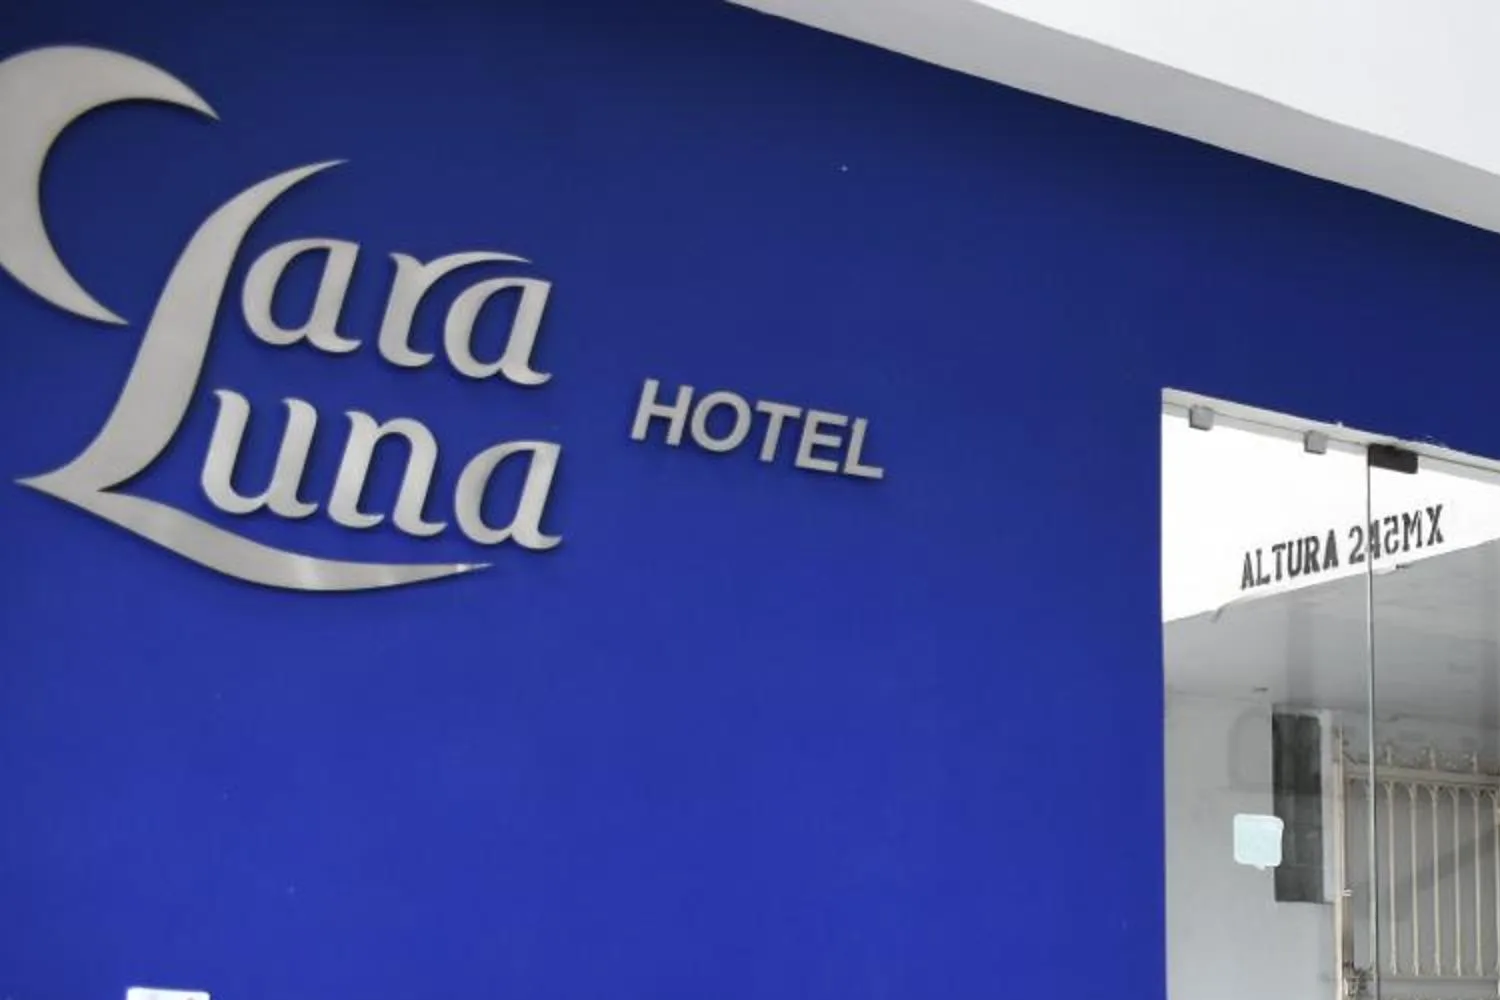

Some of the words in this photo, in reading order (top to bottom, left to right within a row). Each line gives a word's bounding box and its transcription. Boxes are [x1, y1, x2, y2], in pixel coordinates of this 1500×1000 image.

[12, 250, 564, 591] Luna
[630, 377, 885, 480] HOTEL
[1240, 528, 1340, 591] ALTURA
